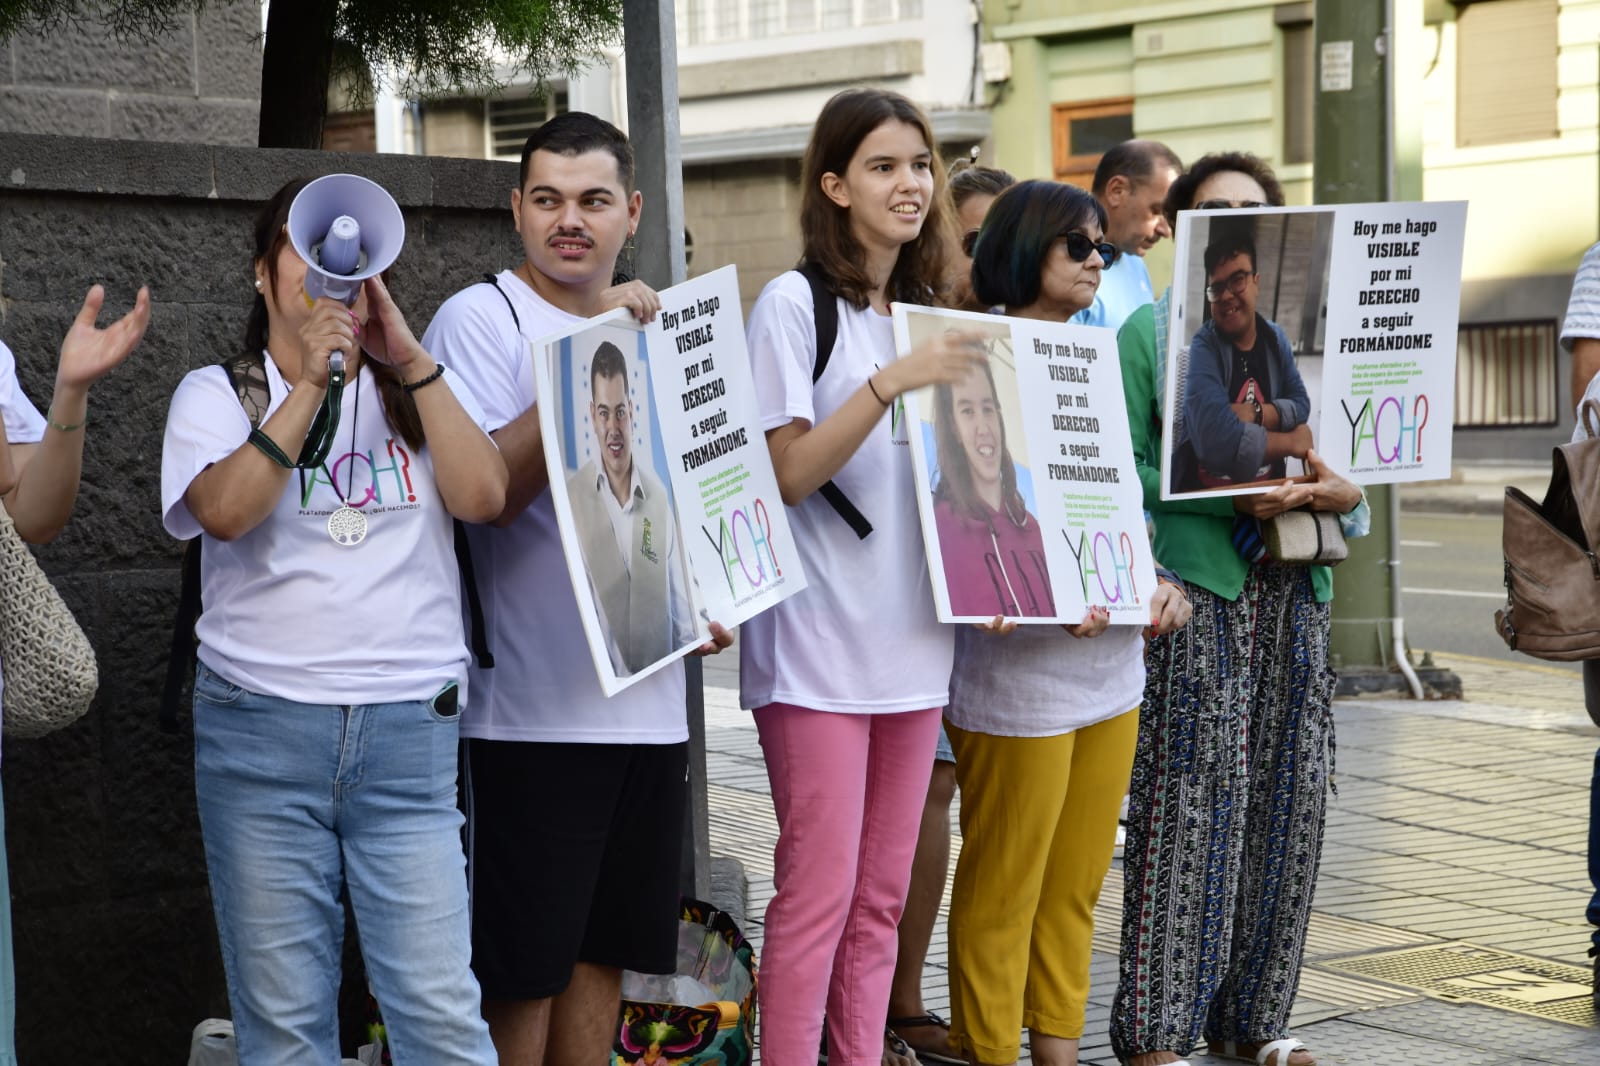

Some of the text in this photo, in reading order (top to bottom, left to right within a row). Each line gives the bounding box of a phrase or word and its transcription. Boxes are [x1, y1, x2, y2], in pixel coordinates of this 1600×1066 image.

[1354, 219, 1437, 239] Hoy me hago
[1368, 242, 1420, 258] VISIBLE
[1370, 266, 1412, 285] por mi
[1359, 288, 1420, 306] DERECHO
[661, 296, 720, 331] Hoy me hago
[1362, 312, 1414, 332] a seguir
[676, 324, 714, 354] VISIBLE
[1340, 332, 1432, 354] FORMÁNDOME
[1033, 338, 1097, 363] Hoy me hago
[684, 353, 714, 385] por mi
[1048, 364, 1089, 384] VISIBLE
[681, 378, 726, 412] DERECHO
[1056, 393, 1088, 409] por mi
[691, 408, 728, 438] a seguir
[1052, 414, 1100, 433] DERECHO
[1341, 394, 1429, 466] YAQH?
[682, 427, 748, 472] FORMÁNDOME
[1060, 442, 1100, 461] a seguir
[1048, 462, 1120, 483] FORMÁNDOME
[1062, 528, 1139, 604] YAQH?
